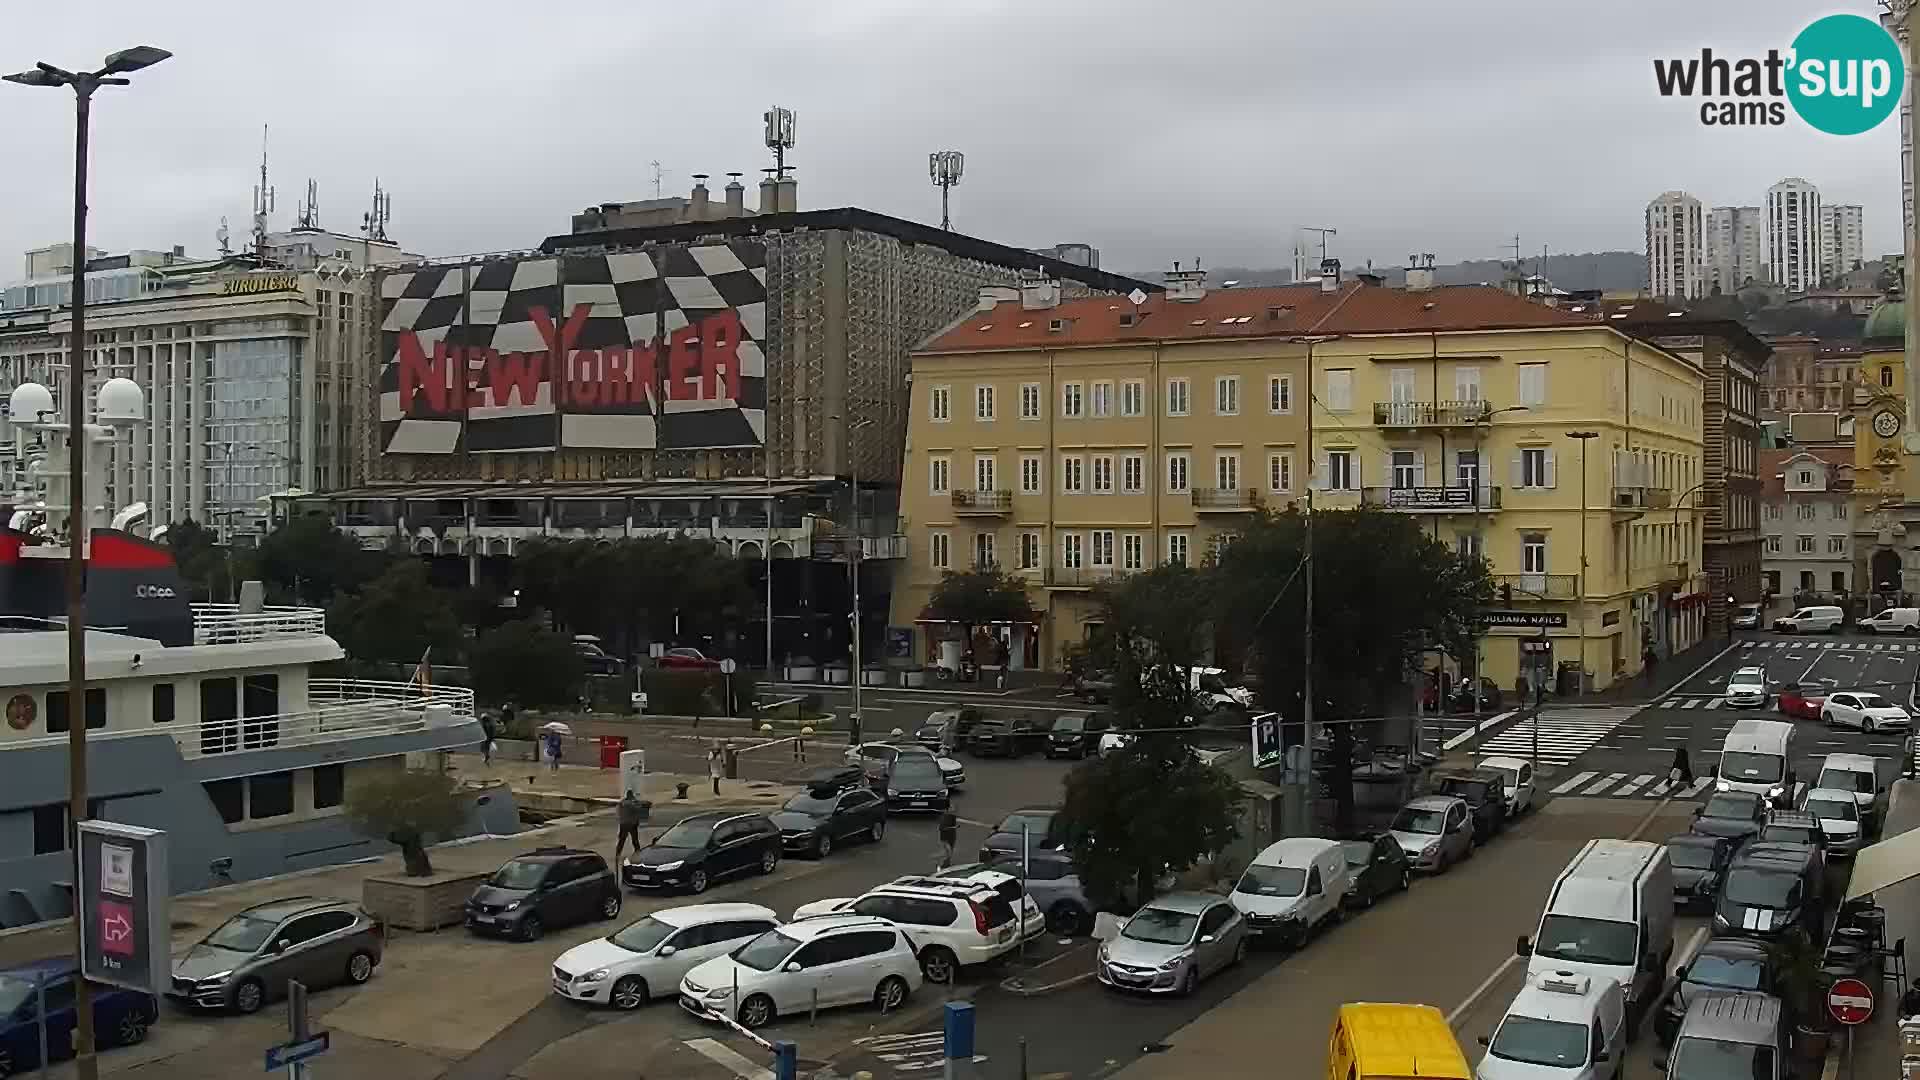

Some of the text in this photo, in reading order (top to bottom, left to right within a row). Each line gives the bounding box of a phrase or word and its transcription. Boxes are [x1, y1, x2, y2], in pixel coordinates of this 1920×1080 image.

[528, 303, 743, 405] YORKER
[1483, 615, 1562, 625] JULIANA NAILS
